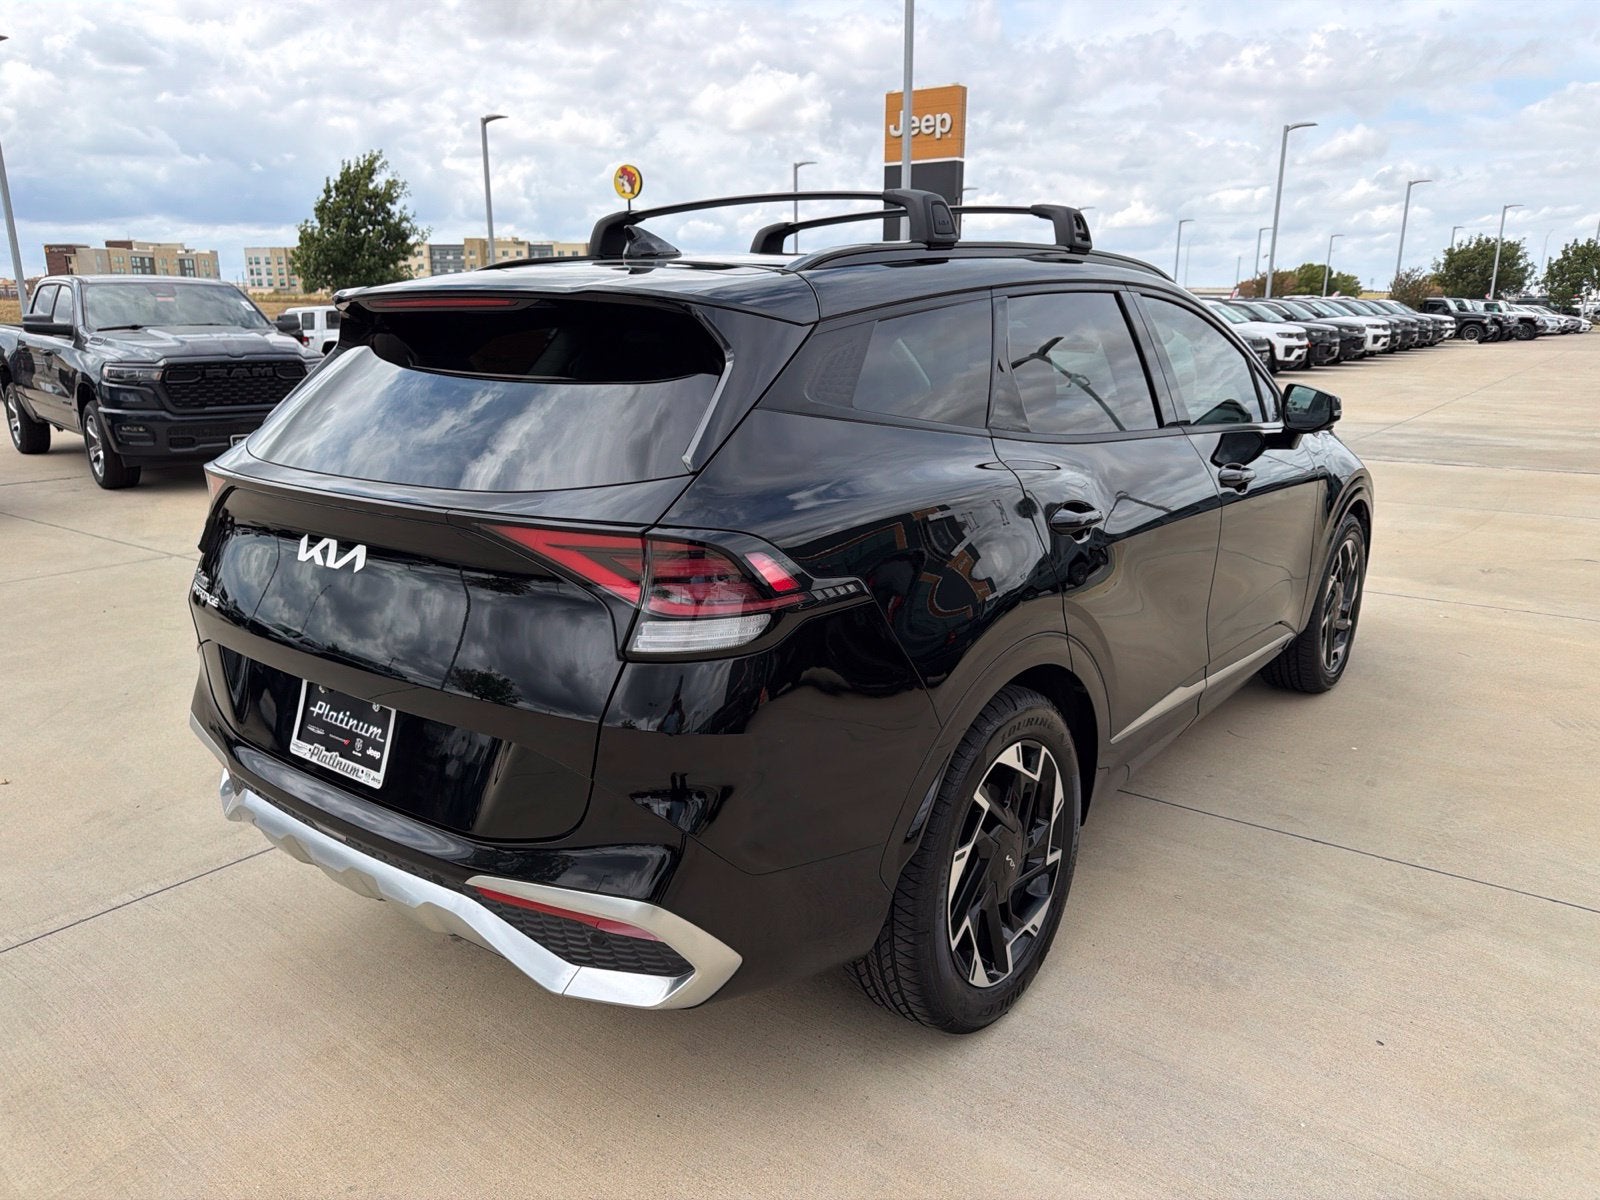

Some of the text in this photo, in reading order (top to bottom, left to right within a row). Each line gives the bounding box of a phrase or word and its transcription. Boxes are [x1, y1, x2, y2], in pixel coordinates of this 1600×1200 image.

[889, 110, 952, 139] Jeep
[205, 367, 274, 379] RAM
[297, 533, 367, 573] KIA
[309, 700, 385, 742] Platinum
[310, 745, 362, 779] Platinum
[366, 746, 381, 760] Jeep
